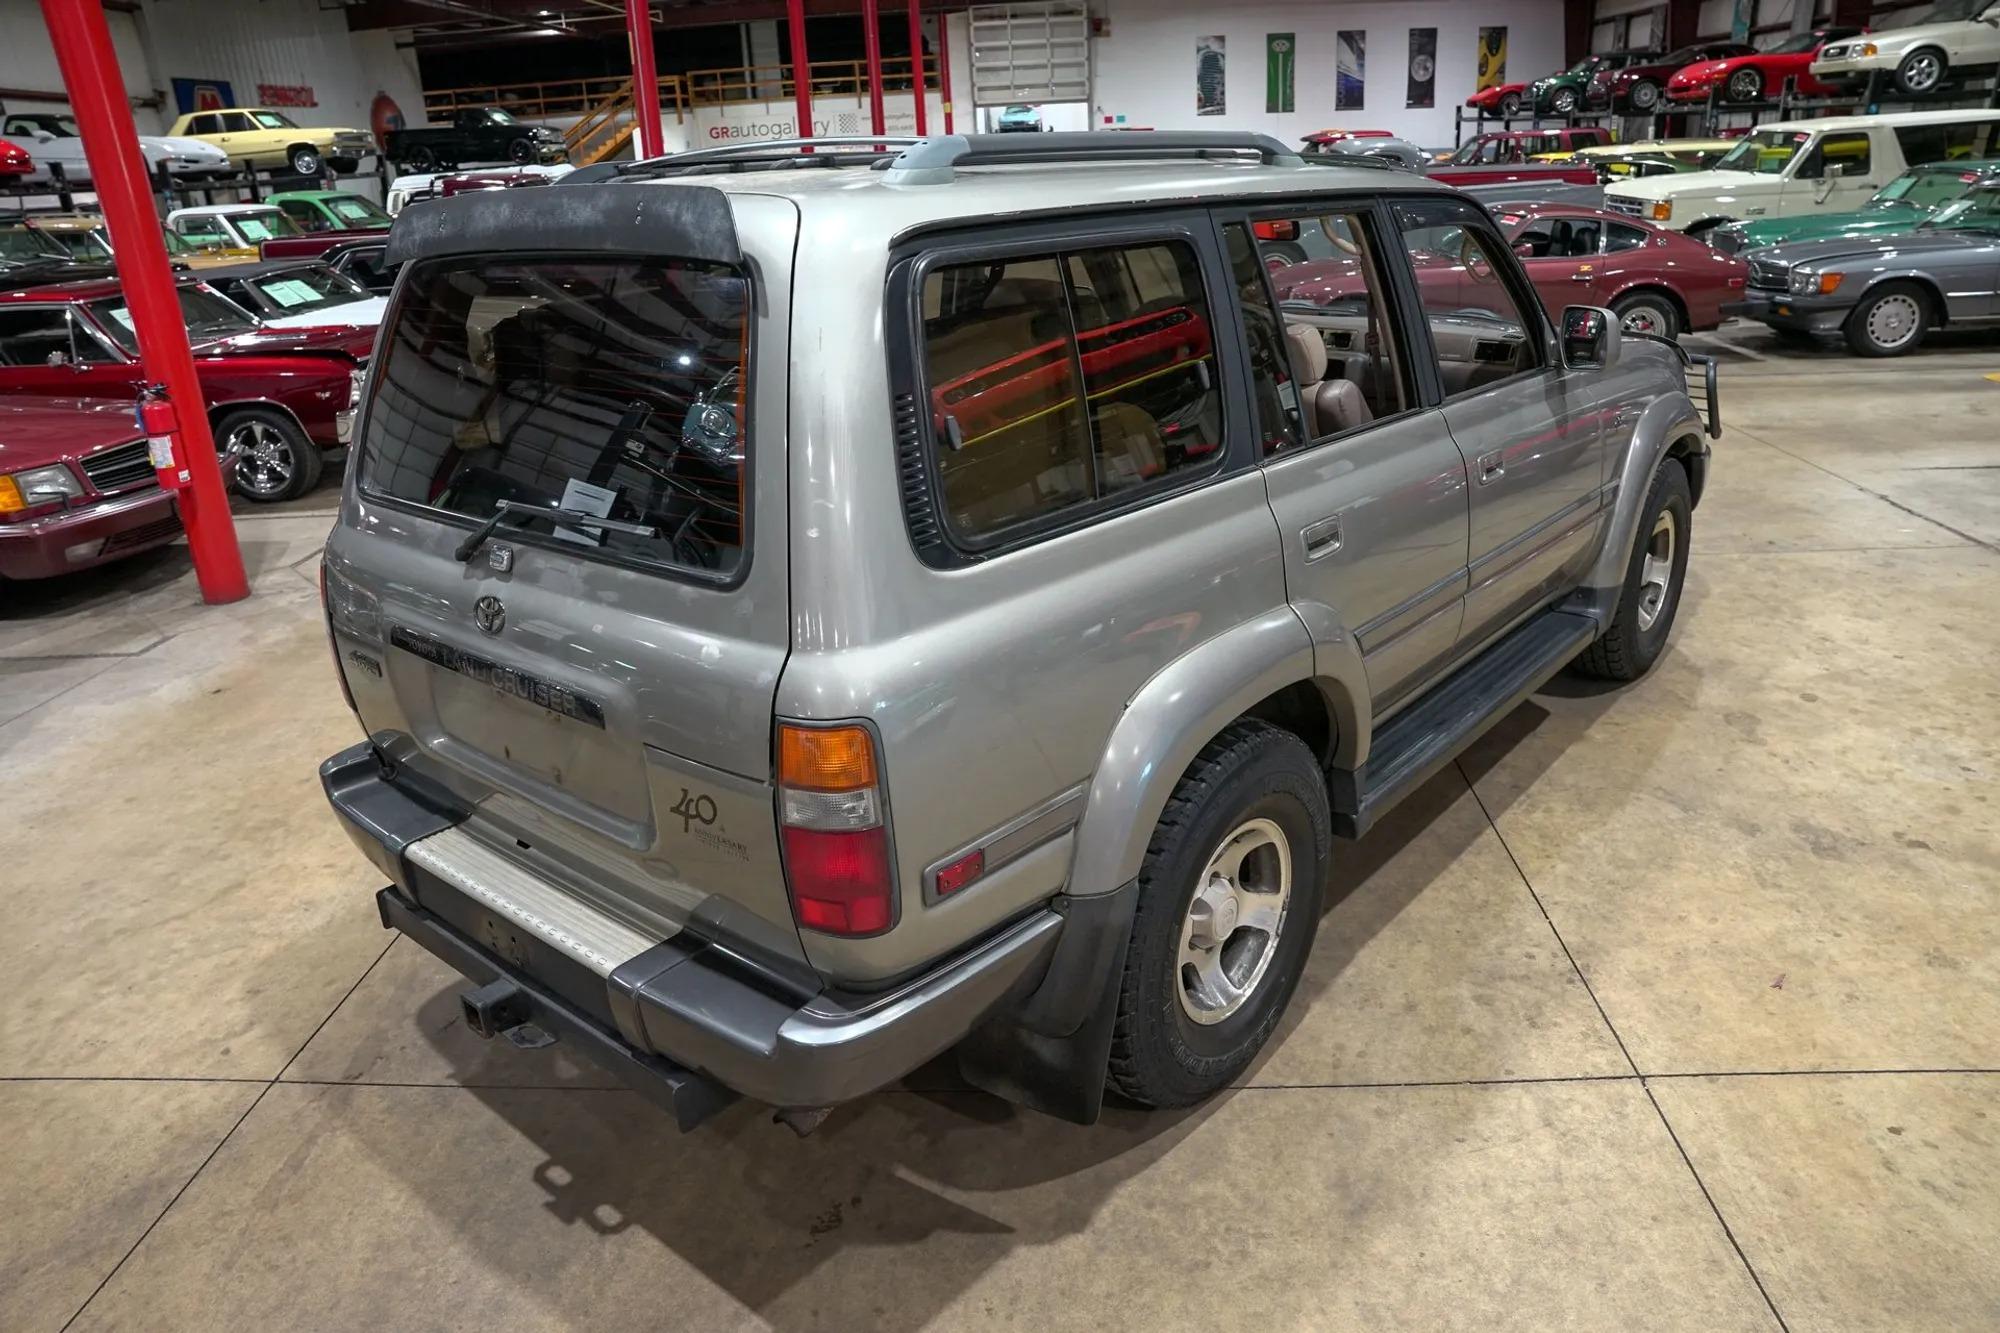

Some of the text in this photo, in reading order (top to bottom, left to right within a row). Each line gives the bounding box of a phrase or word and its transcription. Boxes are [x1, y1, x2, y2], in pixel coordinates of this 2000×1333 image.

[709, 116, 831, 140] GRautogalry
[491, 666, 576, 715] CRUISER
[669, 787, 718, 833] 40
